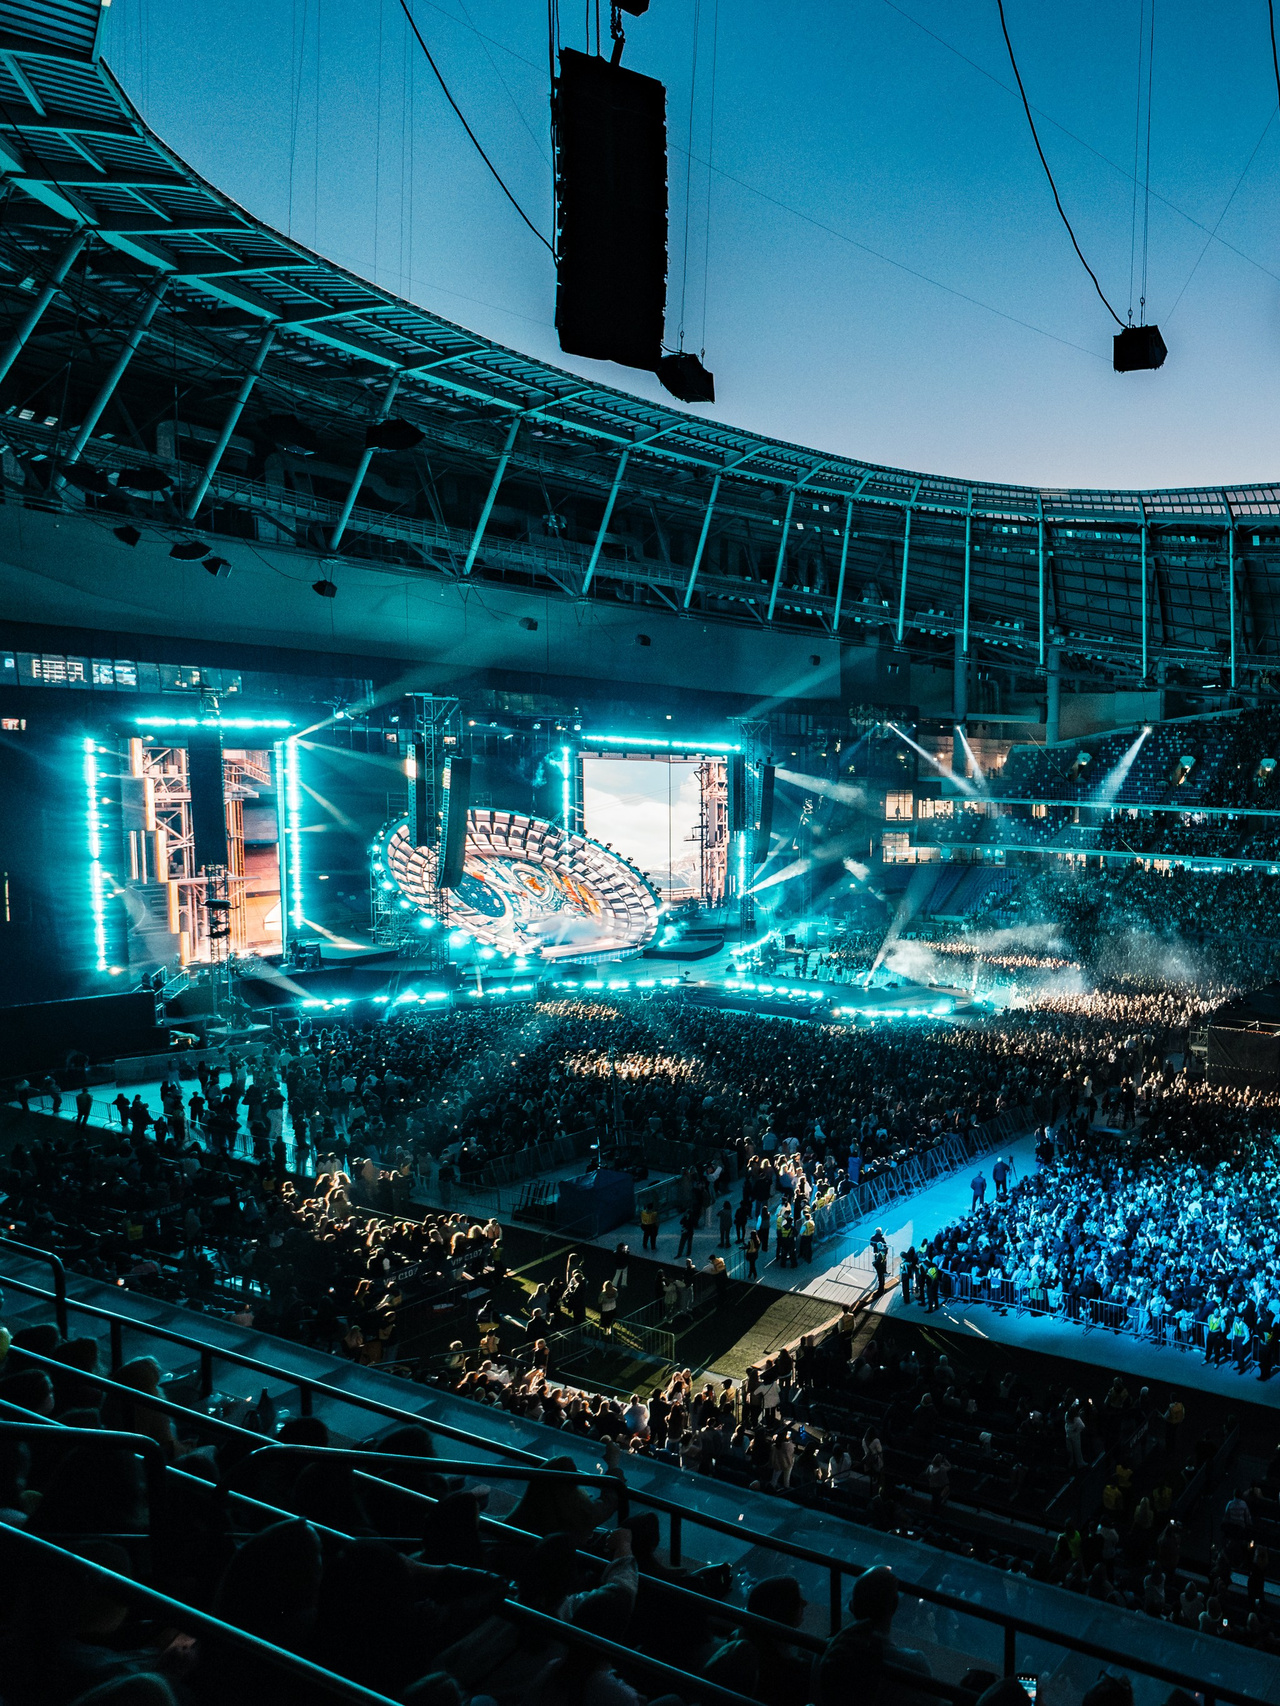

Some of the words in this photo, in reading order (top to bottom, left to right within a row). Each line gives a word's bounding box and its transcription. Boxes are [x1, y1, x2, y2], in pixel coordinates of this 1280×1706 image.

[450, 1256, 463, 1266] VIP
[464, 1248, 483, 1260] C107
[398, 1266, 419, 1281] C107
